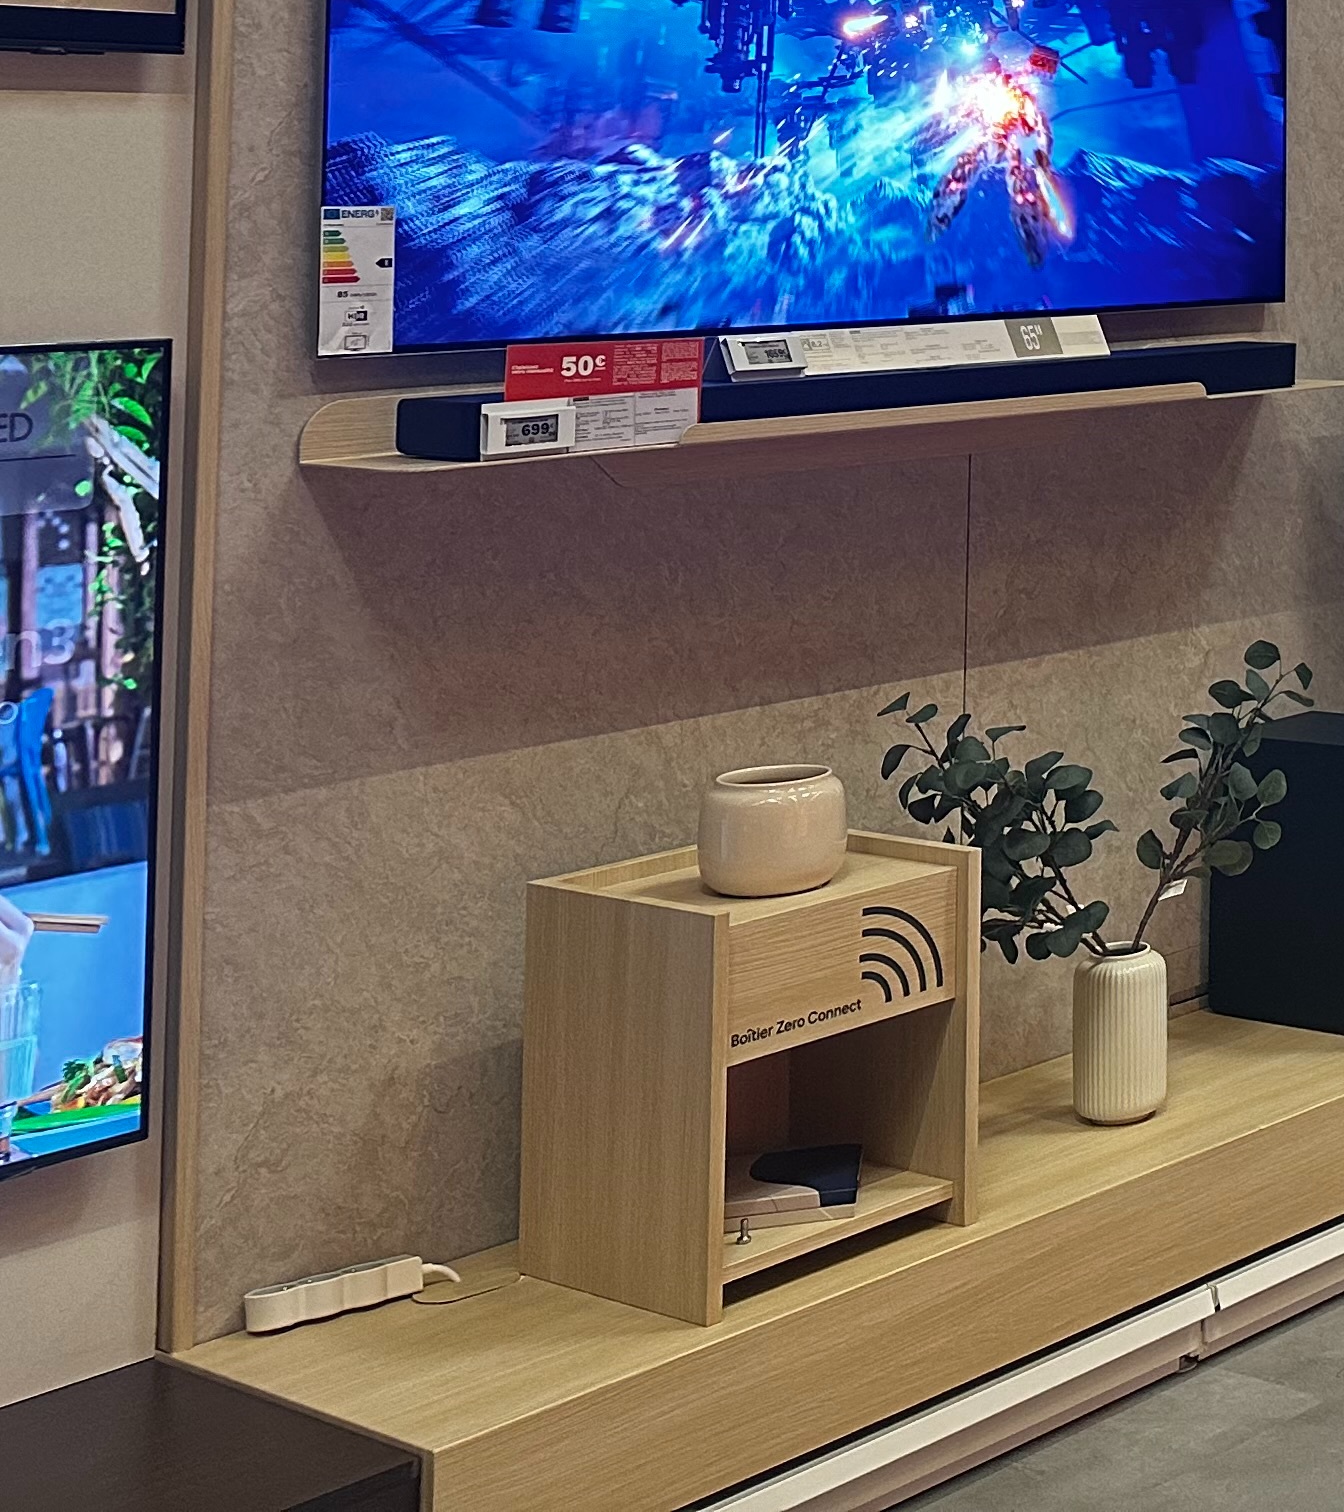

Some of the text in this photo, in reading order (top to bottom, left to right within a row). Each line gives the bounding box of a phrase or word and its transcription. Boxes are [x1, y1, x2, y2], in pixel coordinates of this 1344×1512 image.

[730, 999, 863, 1049] Boîtier Zero Connect
